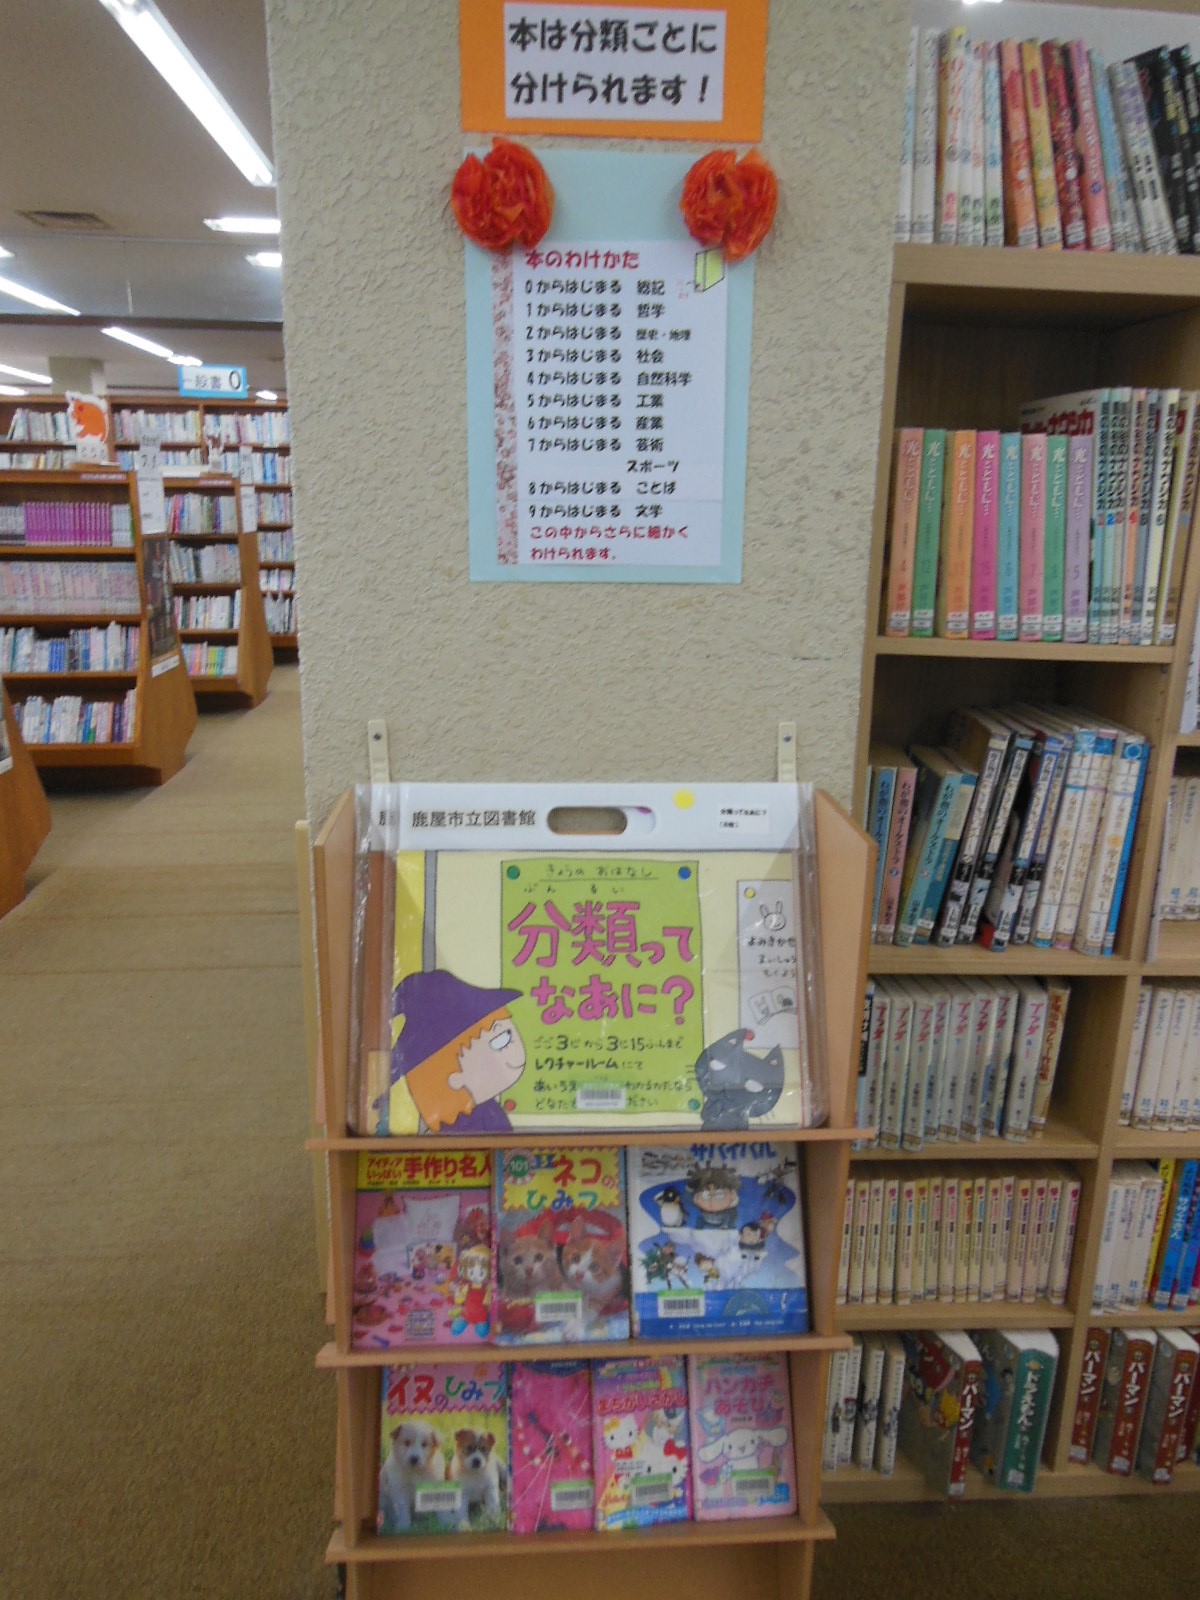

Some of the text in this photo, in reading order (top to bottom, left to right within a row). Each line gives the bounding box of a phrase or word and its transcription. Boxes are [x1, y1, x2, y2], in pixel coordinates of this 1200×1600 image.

[508, 16, 718, 54] 本は分類ごとに
[510, 71, 710, 106] 分けられます！
[525, 250, 640, 270] 本のわけかた
[525, 280, 622, 294] 0からはじまる
[526, 303, 665, 319] 1からはじまる 哲学
[526, 326, 622, 341] 2からはじまる
[526, 349, 665, 364] 3からはじまる 社会
[527, 371, 692, 387] 4からはじまる 自然科学
[528, 394, 622, 408] 5からはじまる
[528, 416, 622, 430] 6からはじまる
[528, 438, 664, 452] 7からはじまる 芸術
[626, 460, 679, 473] スポーツ
[528, 482, 622, 495] 8からはじまる
[528, 504, 663, 518] 9からはじまる 文学
[531, 526, 688, 540] この中からさらに細かく
[412, 809, 537, 828] 鹿屋市立図書館
[507, 900, 694, 969] 分類って
[530, 975, 694, 1025] なあに？
[527, 1189, 599, 1212] ひみつ
[1081, 1351, 1100, 1395] パーマン
[1123, 1361, 1145, 1406] パーマン
[1168, 1373, 1190, 1418] パーマン
[959, 1384, 979, 1431] パーマン
